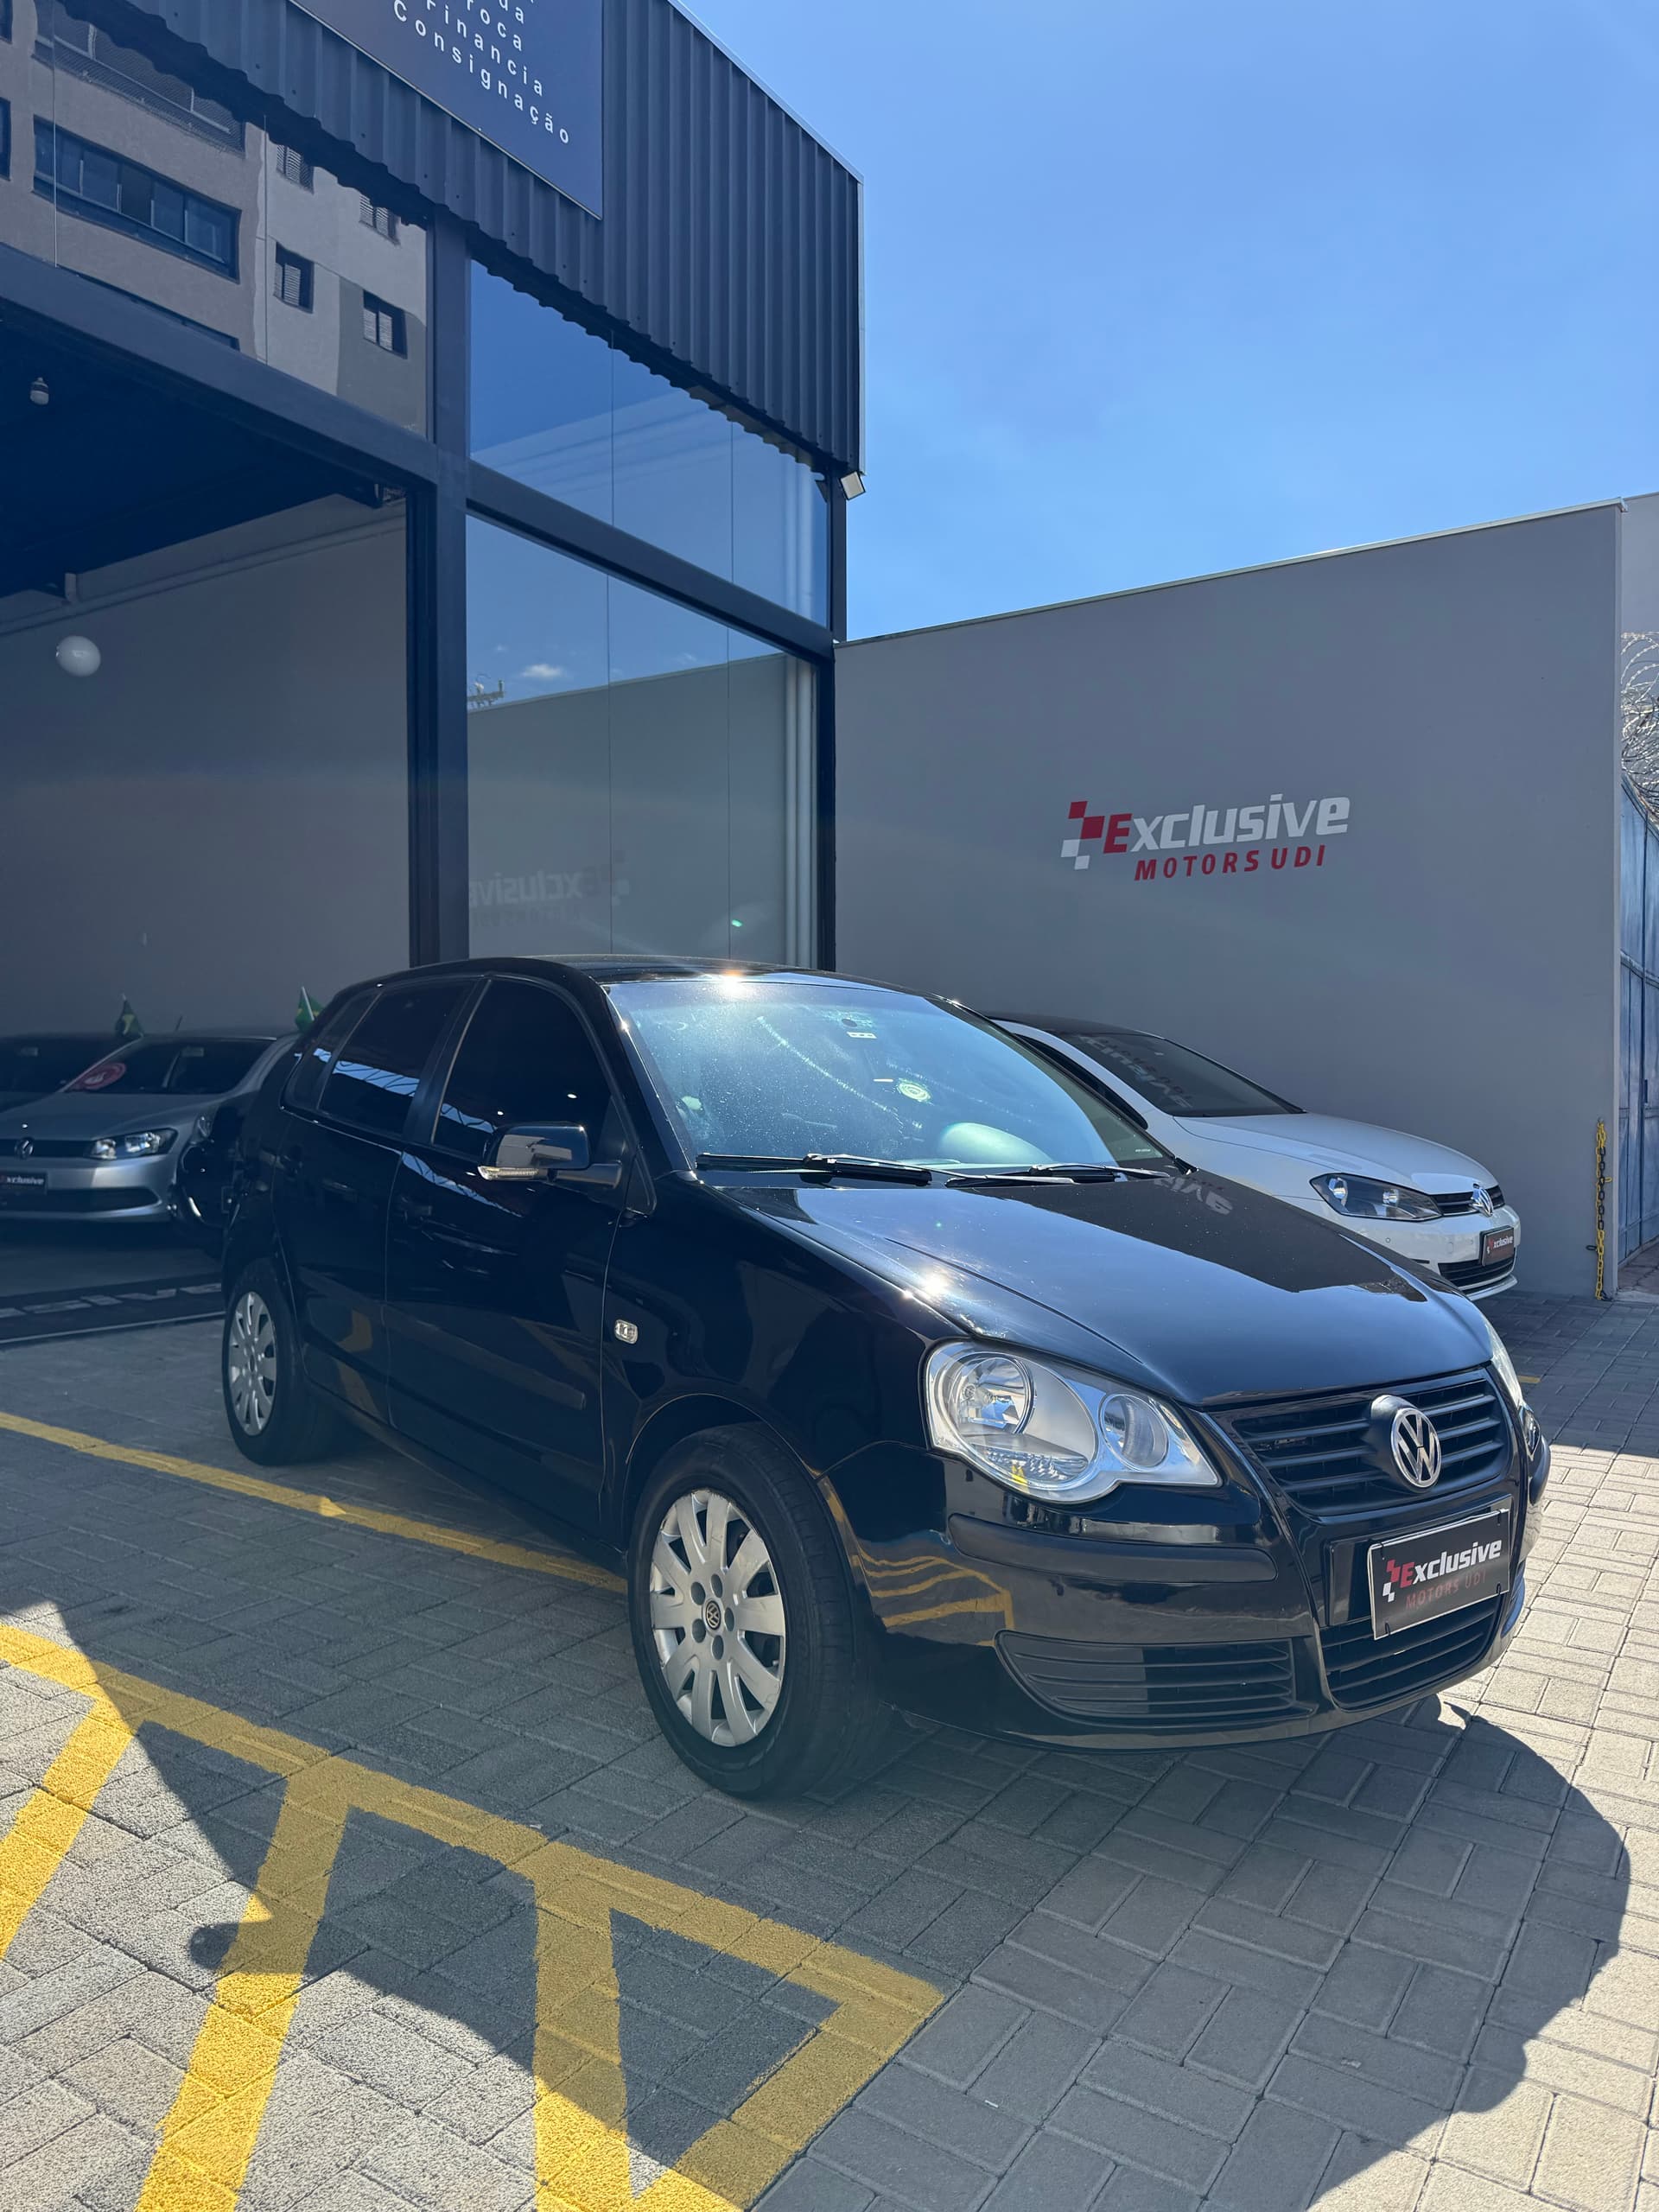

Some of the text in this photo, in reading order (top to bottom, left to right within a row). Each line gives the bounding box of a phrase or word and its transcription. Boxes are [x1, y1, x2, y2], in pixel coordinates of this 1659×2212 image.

[394, 0, 569, 143] Consignação
[1103, 793, 1351, 855] Exclusive
[1134, 844, 1325, 881] MOTORS UDI
[1400, 1540, 1502, 1588] Exclusive
[1405, 1580, 1459, 1611] MOTORS
